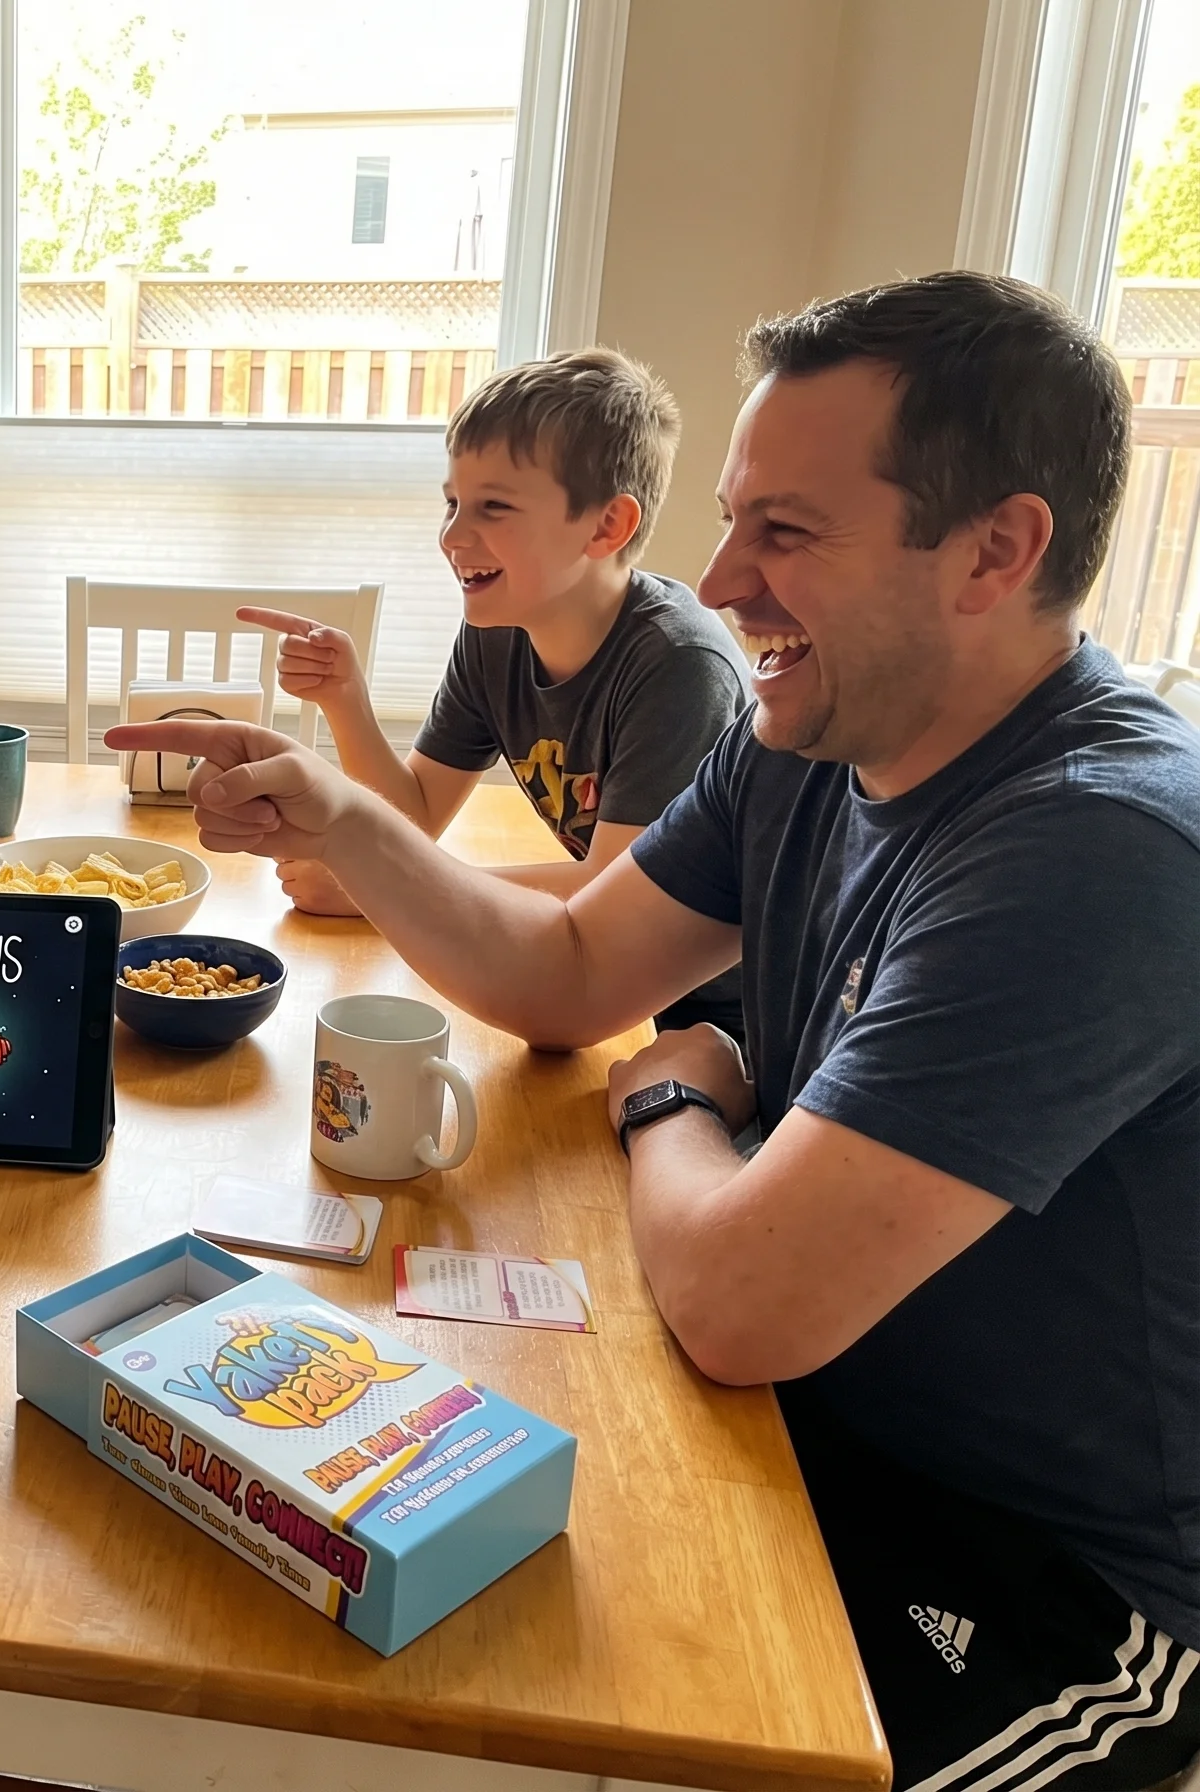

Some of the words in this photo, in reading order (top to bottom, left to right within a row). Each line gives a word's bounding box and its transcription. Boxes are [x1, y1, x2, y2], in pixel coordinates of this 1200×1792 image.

[264, 1349, 377, 1429] pack
[103, 1382, 176, 1472] PAUSE,
[179, 1433, 242, 1516] PLAY,
[908, 1605, 966, 1674] adidas
